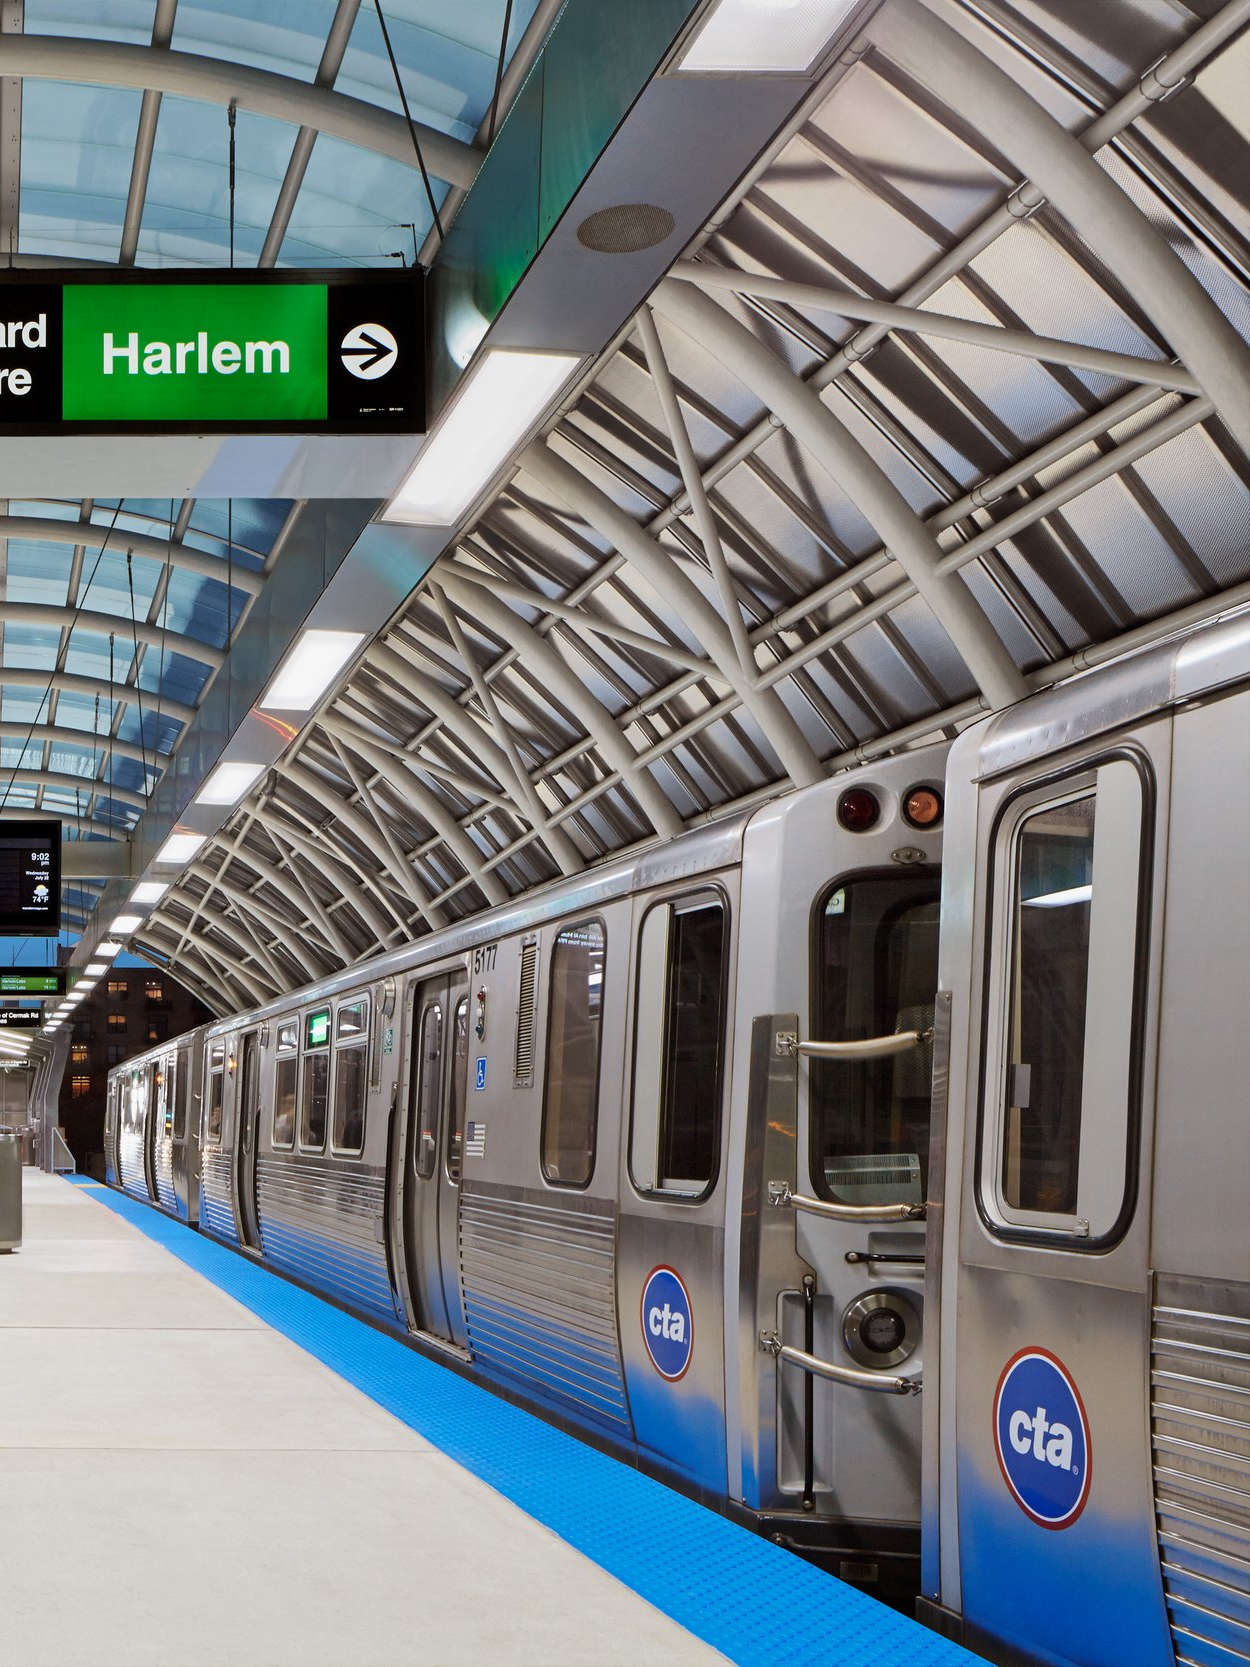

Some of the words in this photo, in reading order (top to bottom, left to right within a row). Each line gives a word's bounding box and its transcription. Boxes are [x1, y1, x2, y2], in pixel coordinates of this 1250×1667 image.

[103, 332, 290, 375] Harlem
[475, 944, 498, 975] 5177
[649, 1302, 684, 1343] cta
[1009, 1406, 1073, 1471] cta
